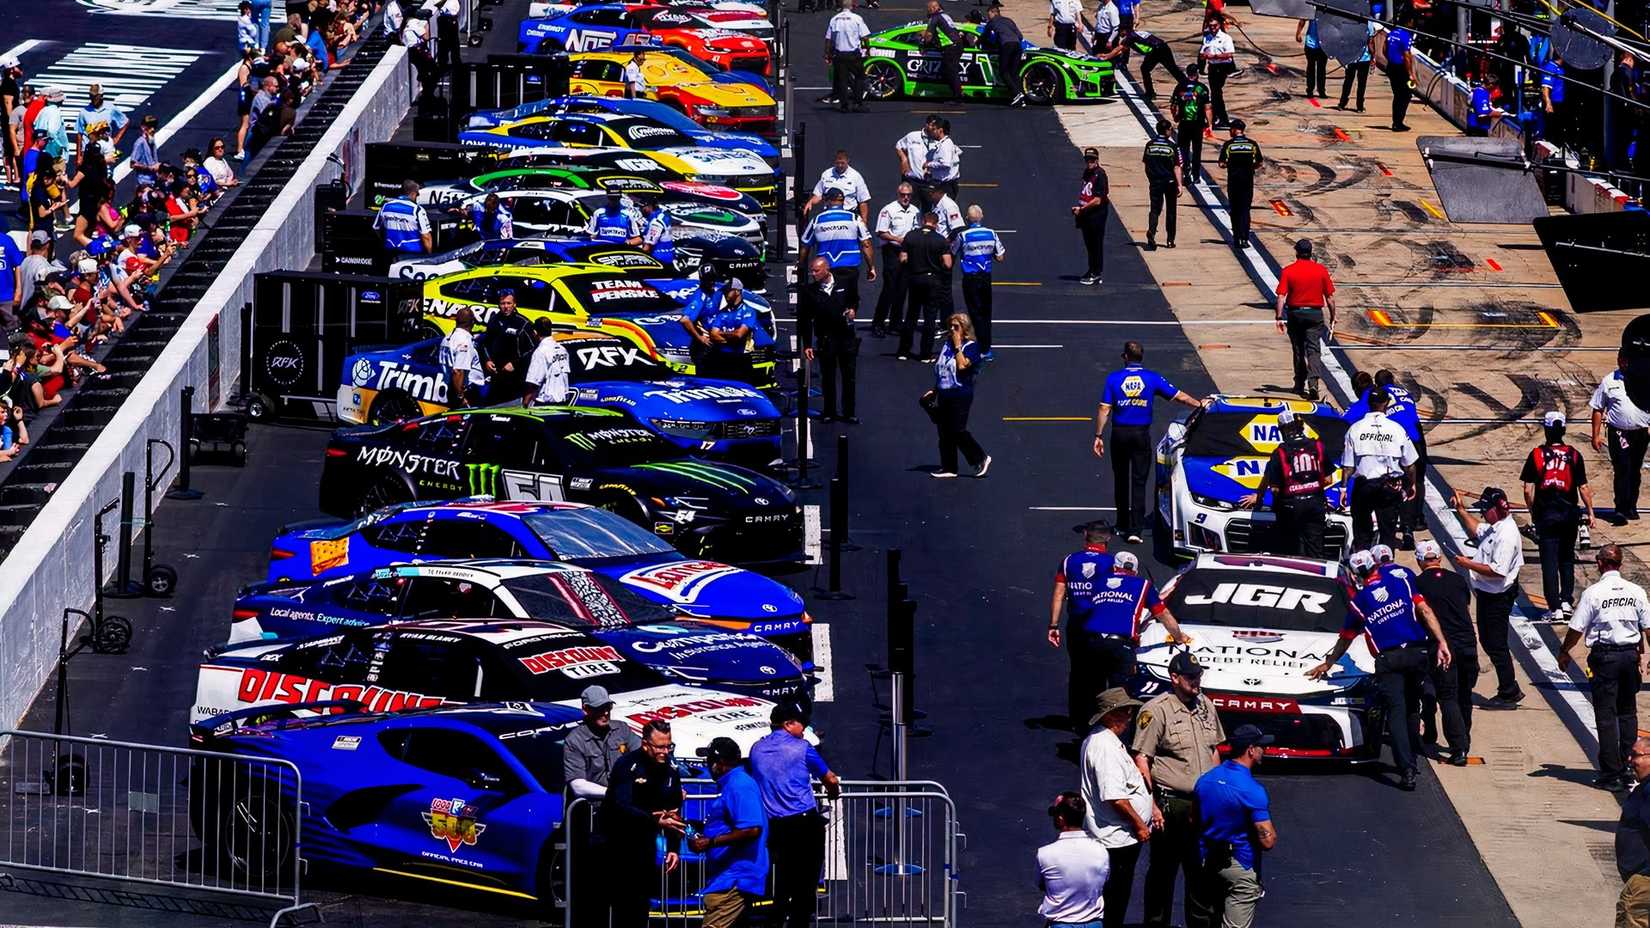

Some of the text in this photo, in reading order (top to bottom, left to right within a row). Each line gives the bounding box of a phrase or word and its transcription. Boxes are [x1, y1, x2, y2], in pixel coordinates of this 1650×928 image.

[592, 281, 642, 291] TEAM
[592, 290, 660, 303] PENSKE
[576, 346, 659, 371] RFK
[377, 360, 449, 402] Trimb
[1359, 432, 1393, 443] OFFICIAL
[745, 513, 790, 524] CAMRY
[1194, 512, 1208, 525] 9
[1184, 583, 1333, 614] JGR
[270, 607, 290, 617] Local
[316, 613, 344, 625] Expert
[754, 621, 801, 633] CAMRY
[518, 645, 626, 675] DISCOUNT
[1199, 655, 1309, 669] DEBT RELIEF
[566, 661, 614, 676] TIRE
[1212, 698, 1292, 710] CAMRY
[707, 710, 756, 722] TIRE
